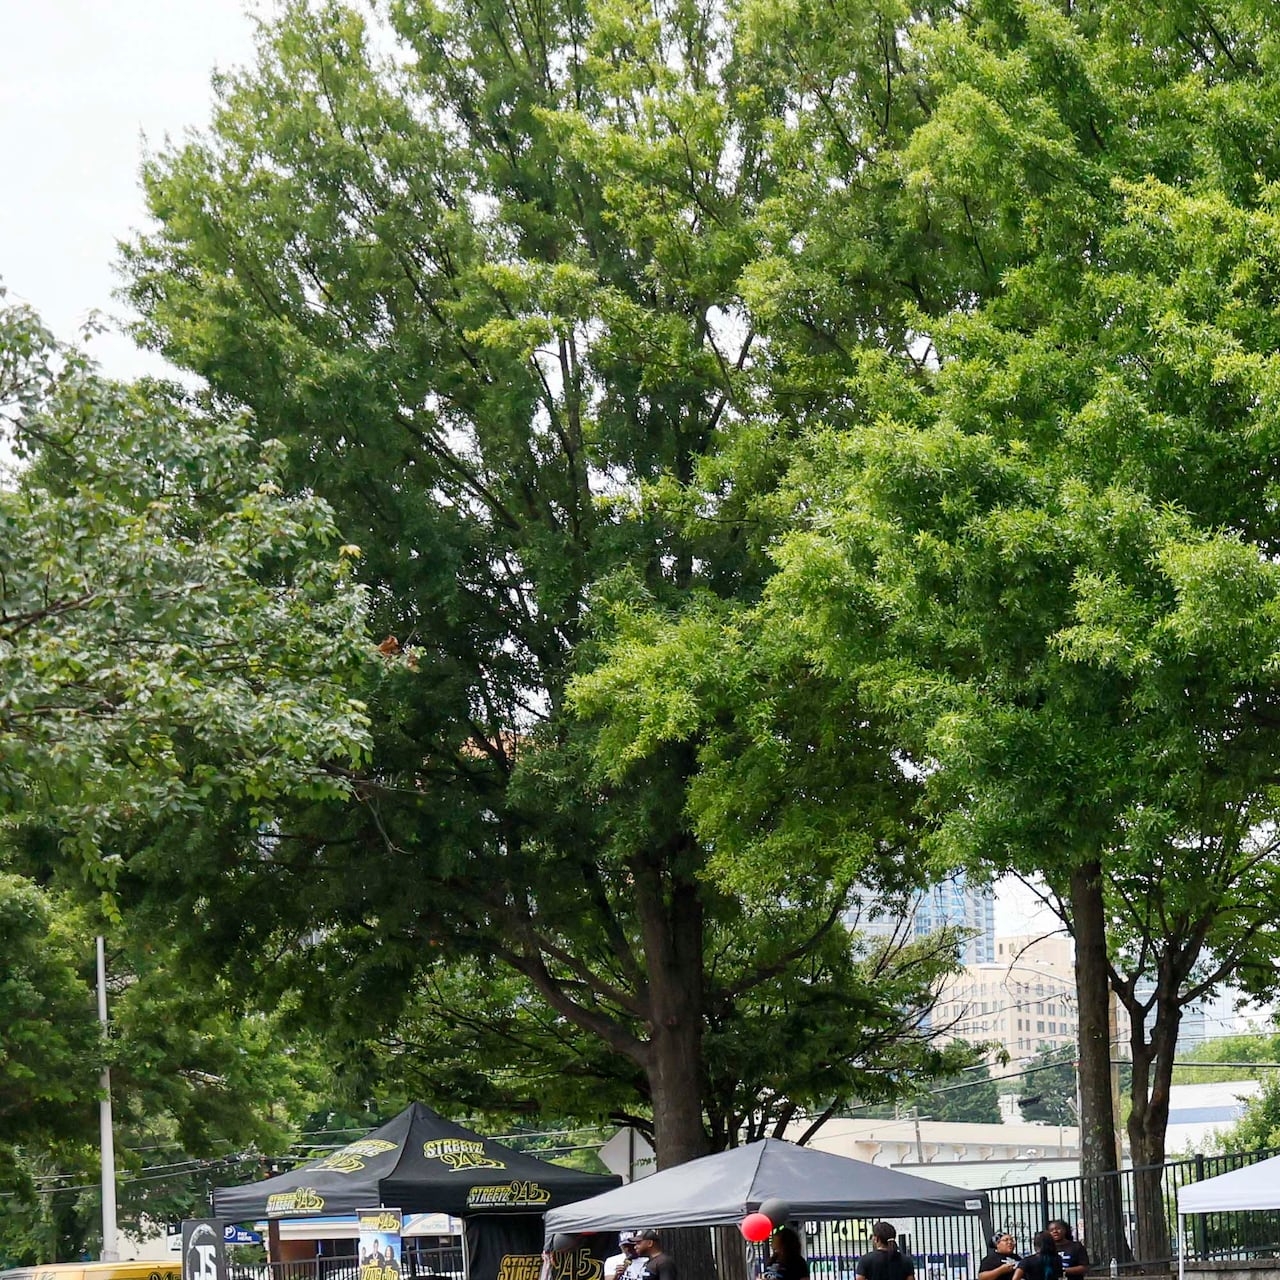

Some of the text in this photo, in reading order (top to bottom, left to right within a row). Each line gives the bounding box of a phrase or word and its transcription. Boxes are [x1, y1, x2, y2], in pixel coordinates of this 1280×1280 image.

[424, 1139, 485, 1158] STREETZ
[296, 1187, 317, 1208] 945
[467, 1180, 540, 1203] STREETZ 945
